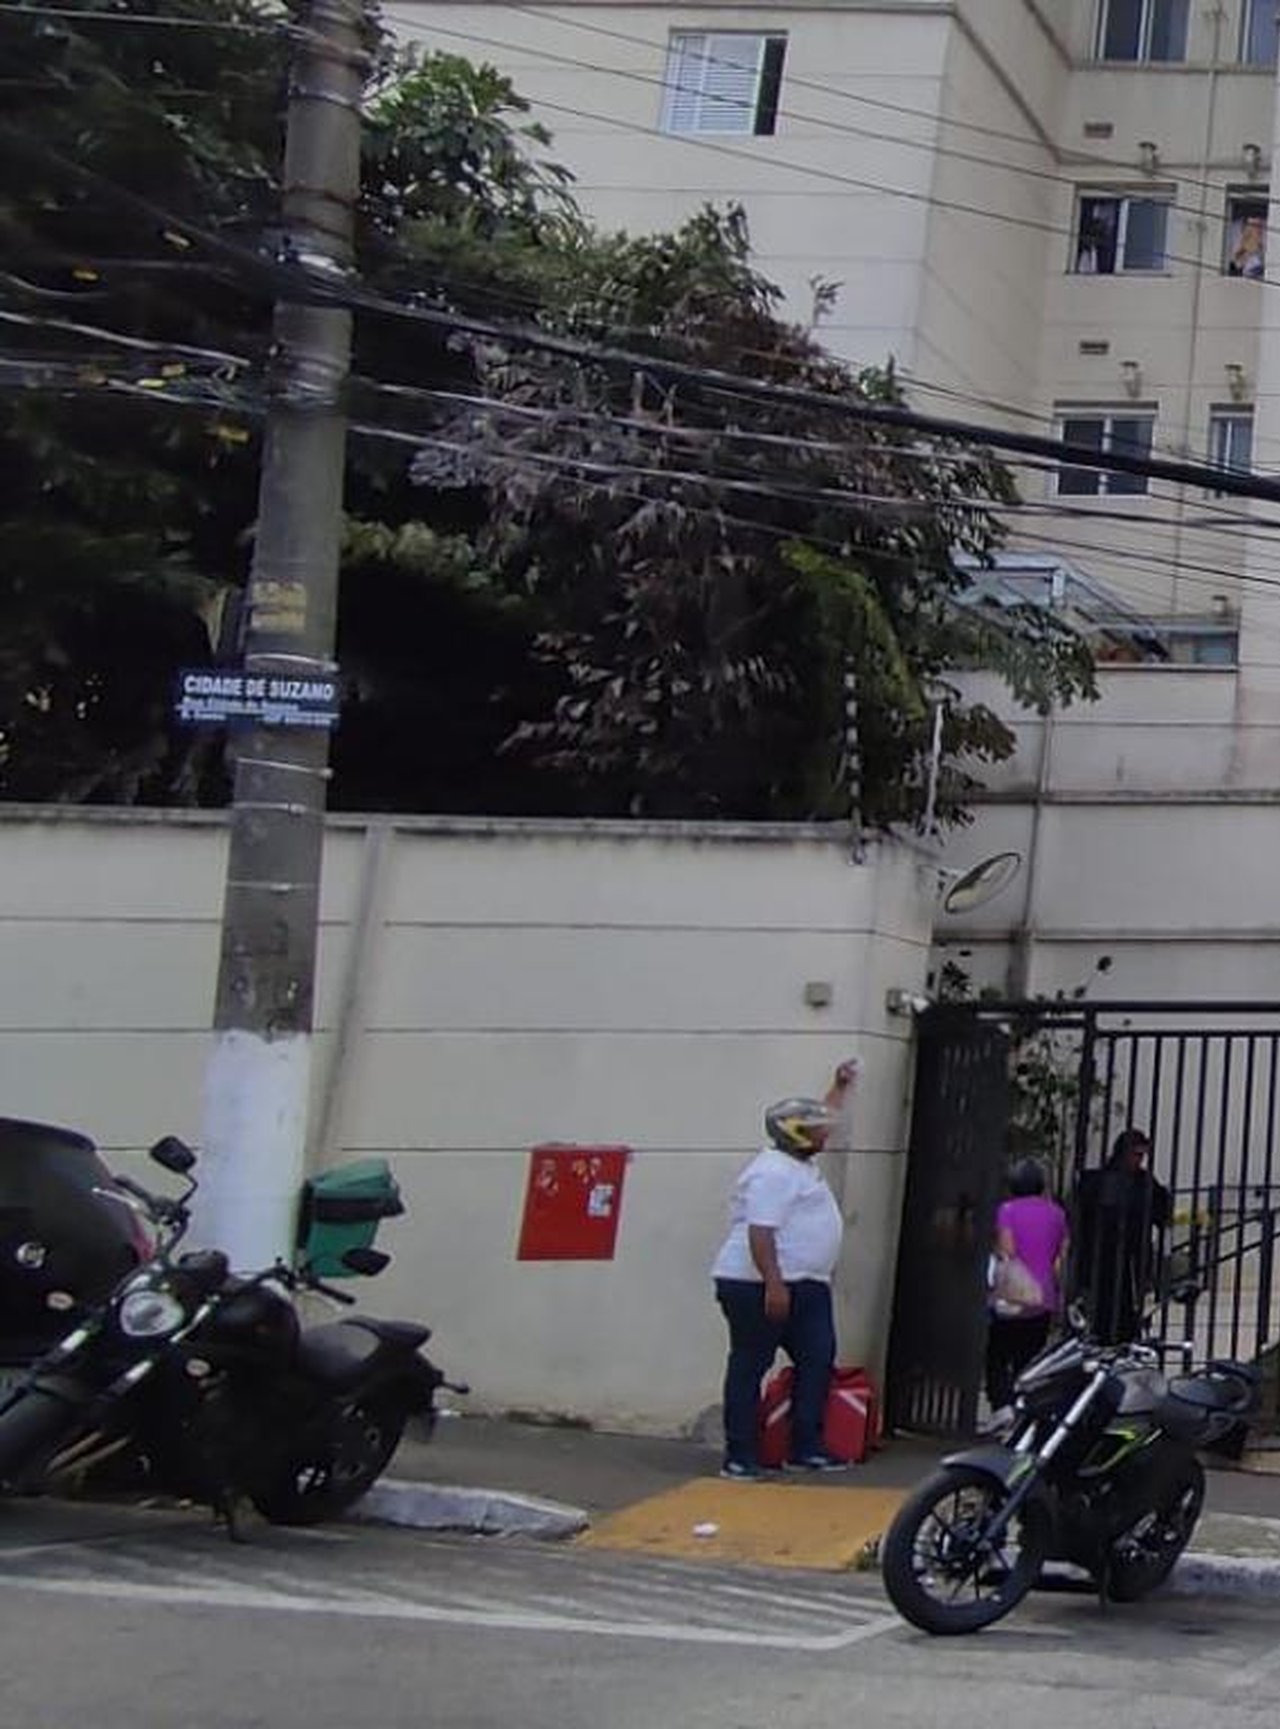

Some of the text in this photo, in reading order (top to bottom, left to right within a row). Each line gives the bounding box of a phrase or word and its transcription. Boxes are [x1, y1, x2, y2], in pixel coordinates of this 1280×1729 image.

[184, 675, 335, 700] CIDADE DE SUZANO
